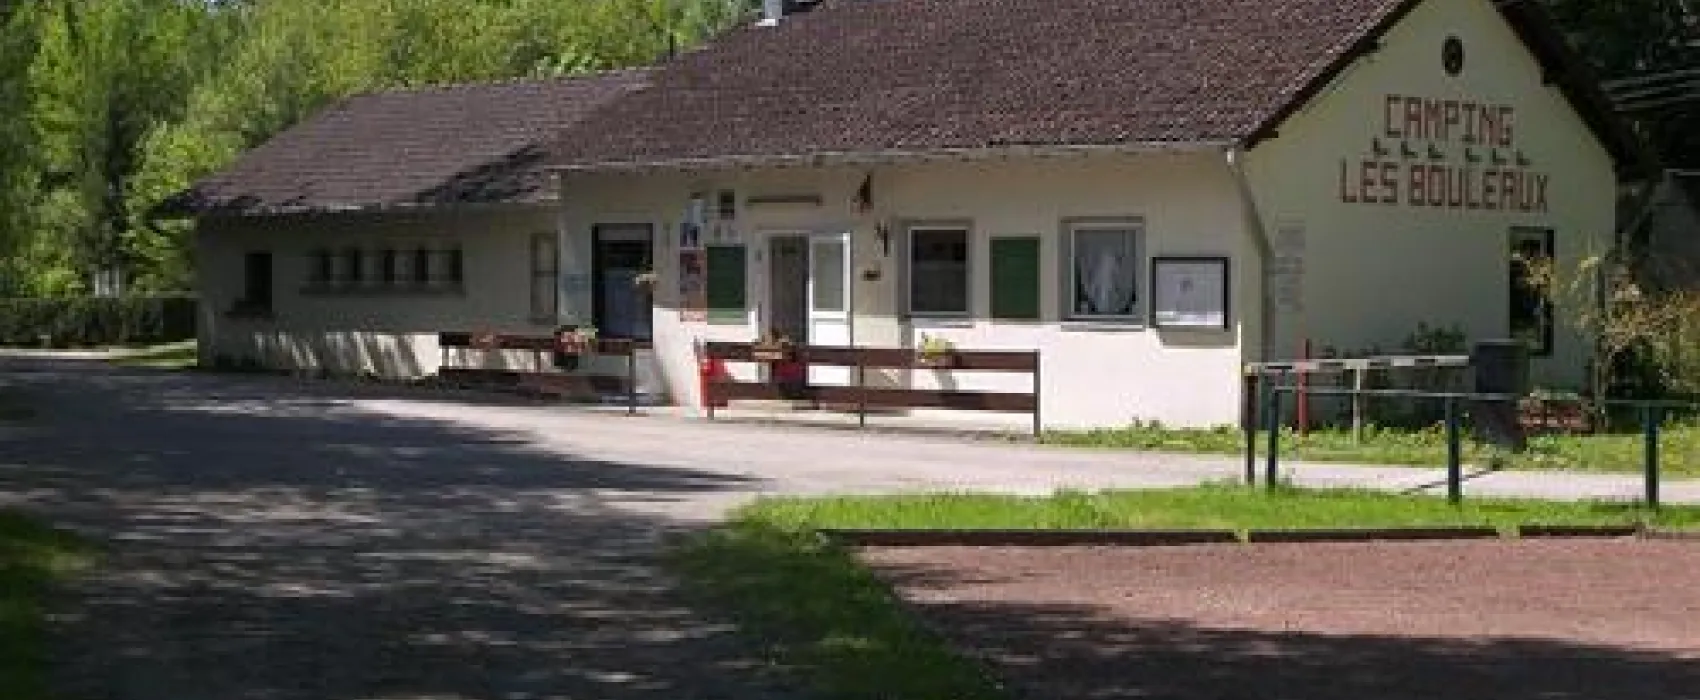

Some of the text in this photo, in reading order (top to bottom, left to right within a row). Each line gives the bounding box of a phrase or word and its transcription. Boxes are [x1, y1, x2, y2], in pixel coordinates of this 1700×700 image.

[1385, 94, 1514, 147] CAMPING
[1341, 157, 1549, 212] LES BOULEAUX
